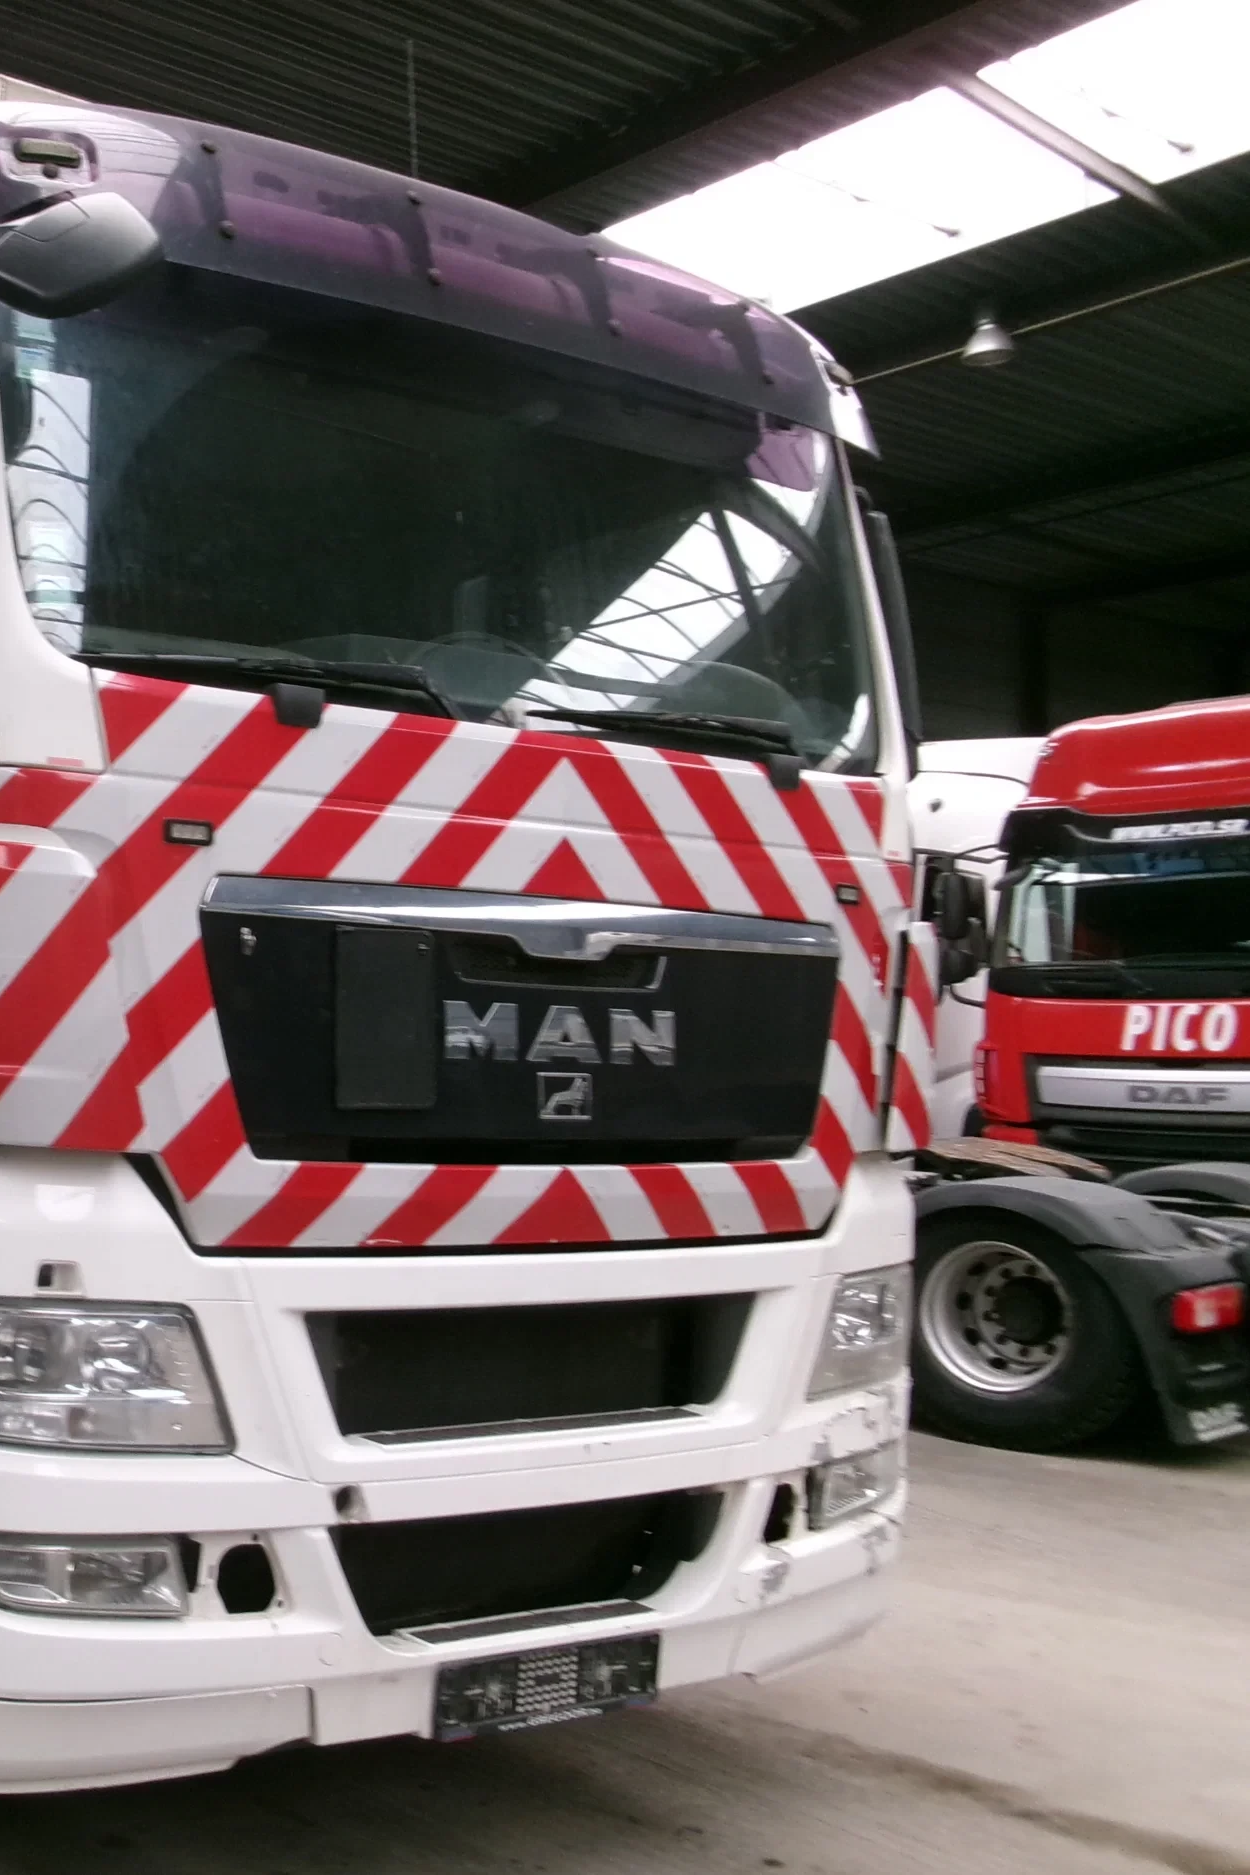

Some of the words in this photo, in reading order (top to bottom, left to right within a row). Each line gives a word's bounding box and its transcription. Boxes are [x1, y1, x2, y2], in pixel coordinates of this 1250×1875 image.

[442, 999, 677, 1067] MAN
[1120, 1003, 1239, 1053] PICO
[1126, 1085, 1230, 1105] DAF
